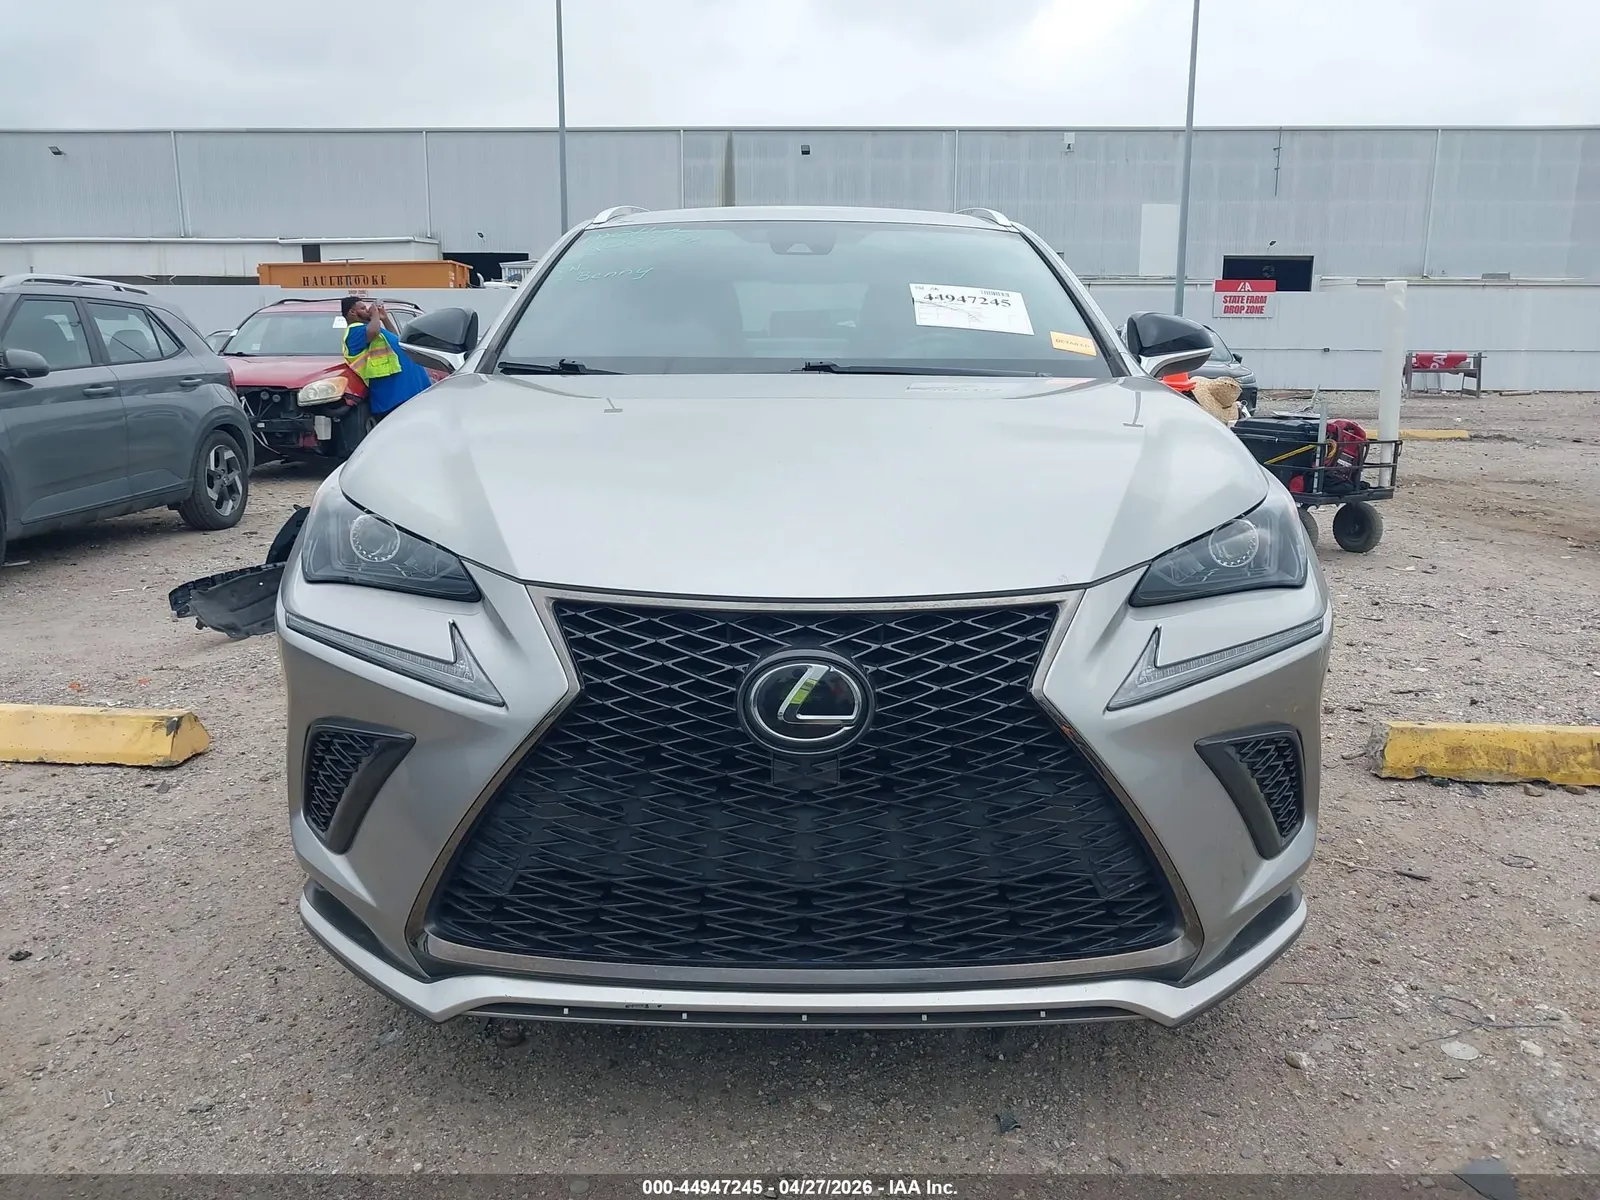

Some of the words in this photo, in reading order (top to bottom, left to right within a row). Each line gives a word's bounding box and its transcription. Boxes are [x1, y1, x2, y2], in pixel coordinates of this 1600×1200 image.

[302, 274, 387, 287] HAULBROOKE
[923, 293, 1011, 308] 44947245
[1222, 295, 1246, 304] STATE
[1245, 295, 1268, 304] FARM
[1223, 305, 1246, 315] DROP
[1245, 305, 1265, 315] ZONE
